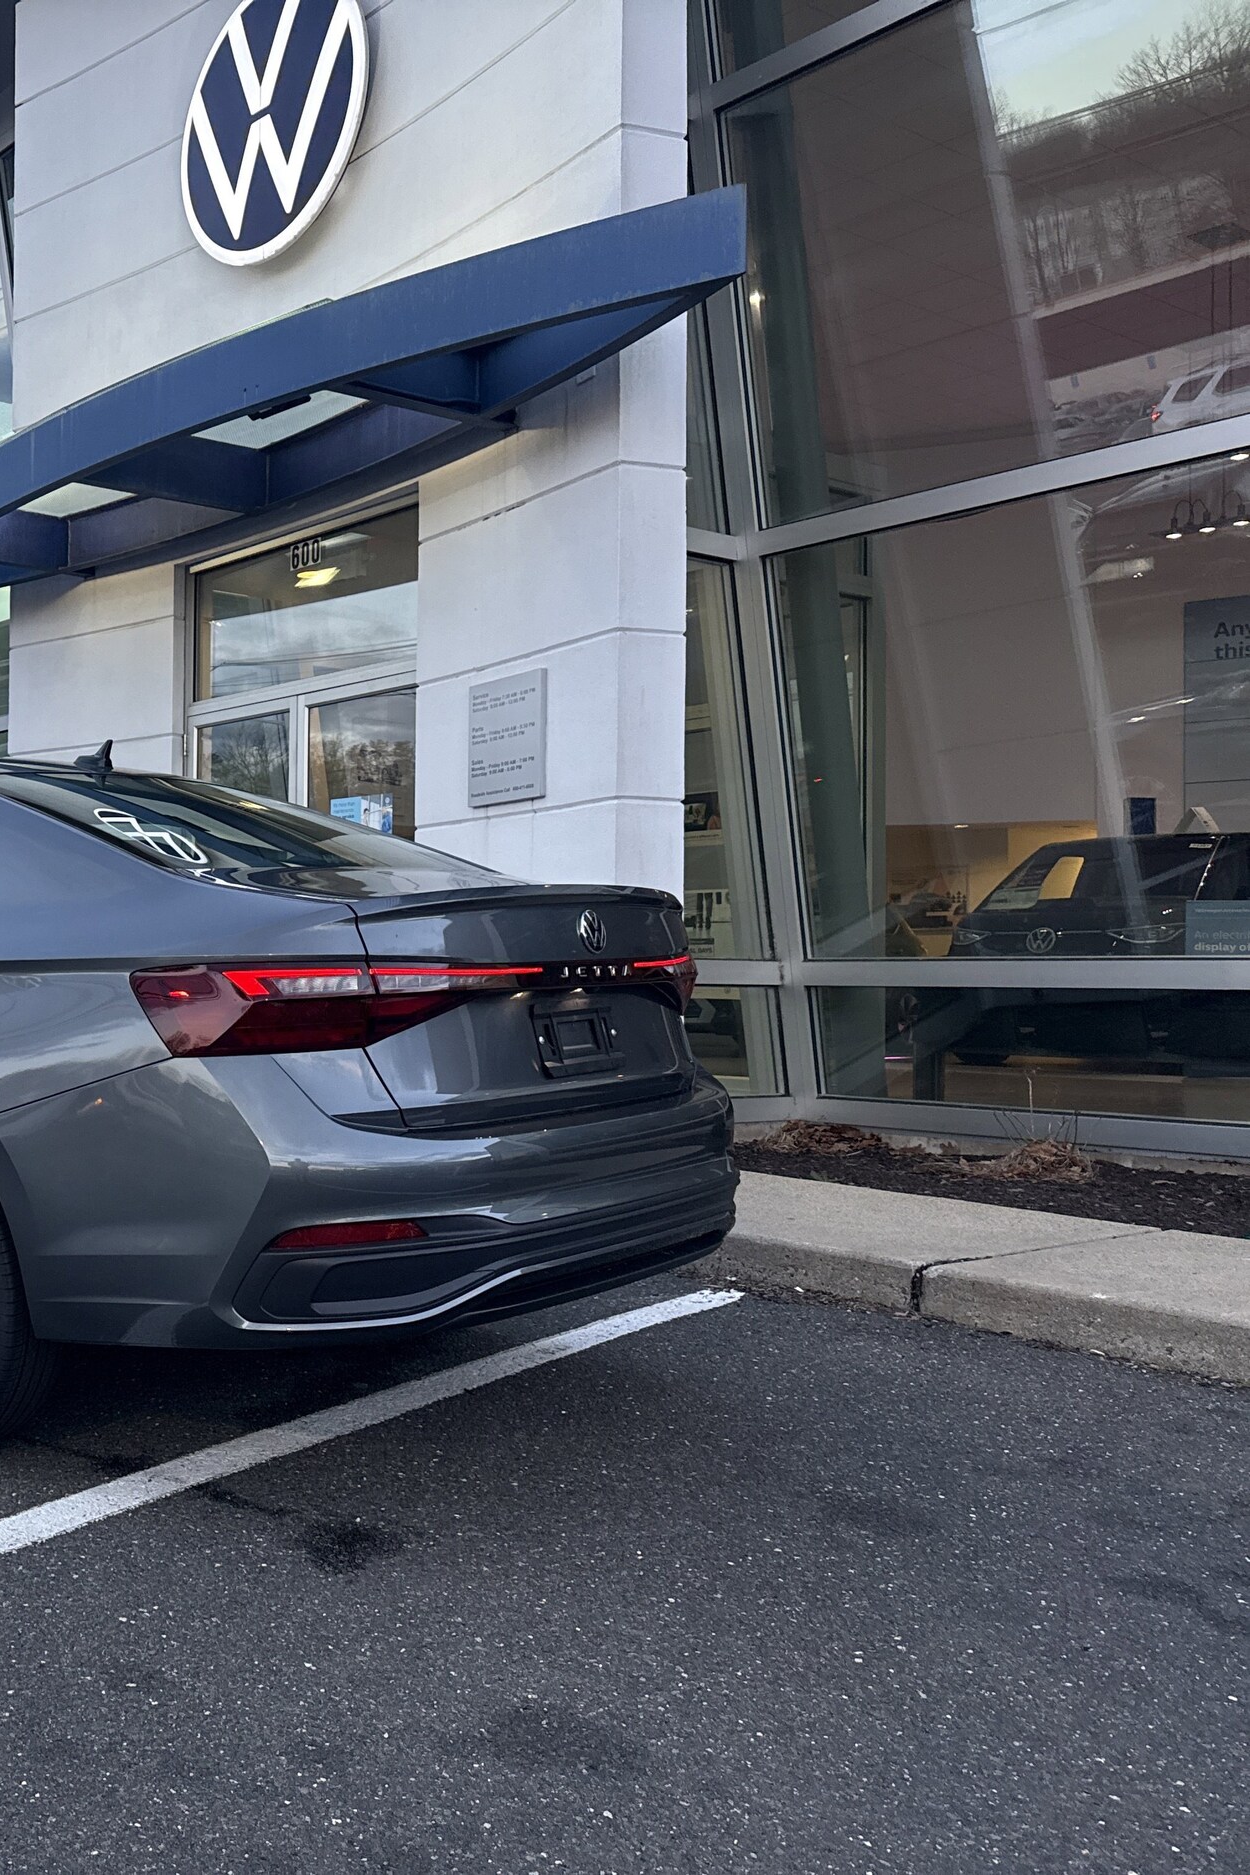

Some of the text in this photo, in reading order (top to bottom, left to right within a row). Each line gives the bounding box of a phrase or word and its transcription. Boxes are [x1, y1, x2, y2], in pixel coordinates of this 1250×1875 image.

[291, 539, 319, 569] 600
[472, 693, 489, 701] Service
[472, 705, 488, 713] Saturday
[1194, 930, 1209, 939] An
[1194, 942, 1236, 953] display
[561, 964, 632, 978] JETTA
